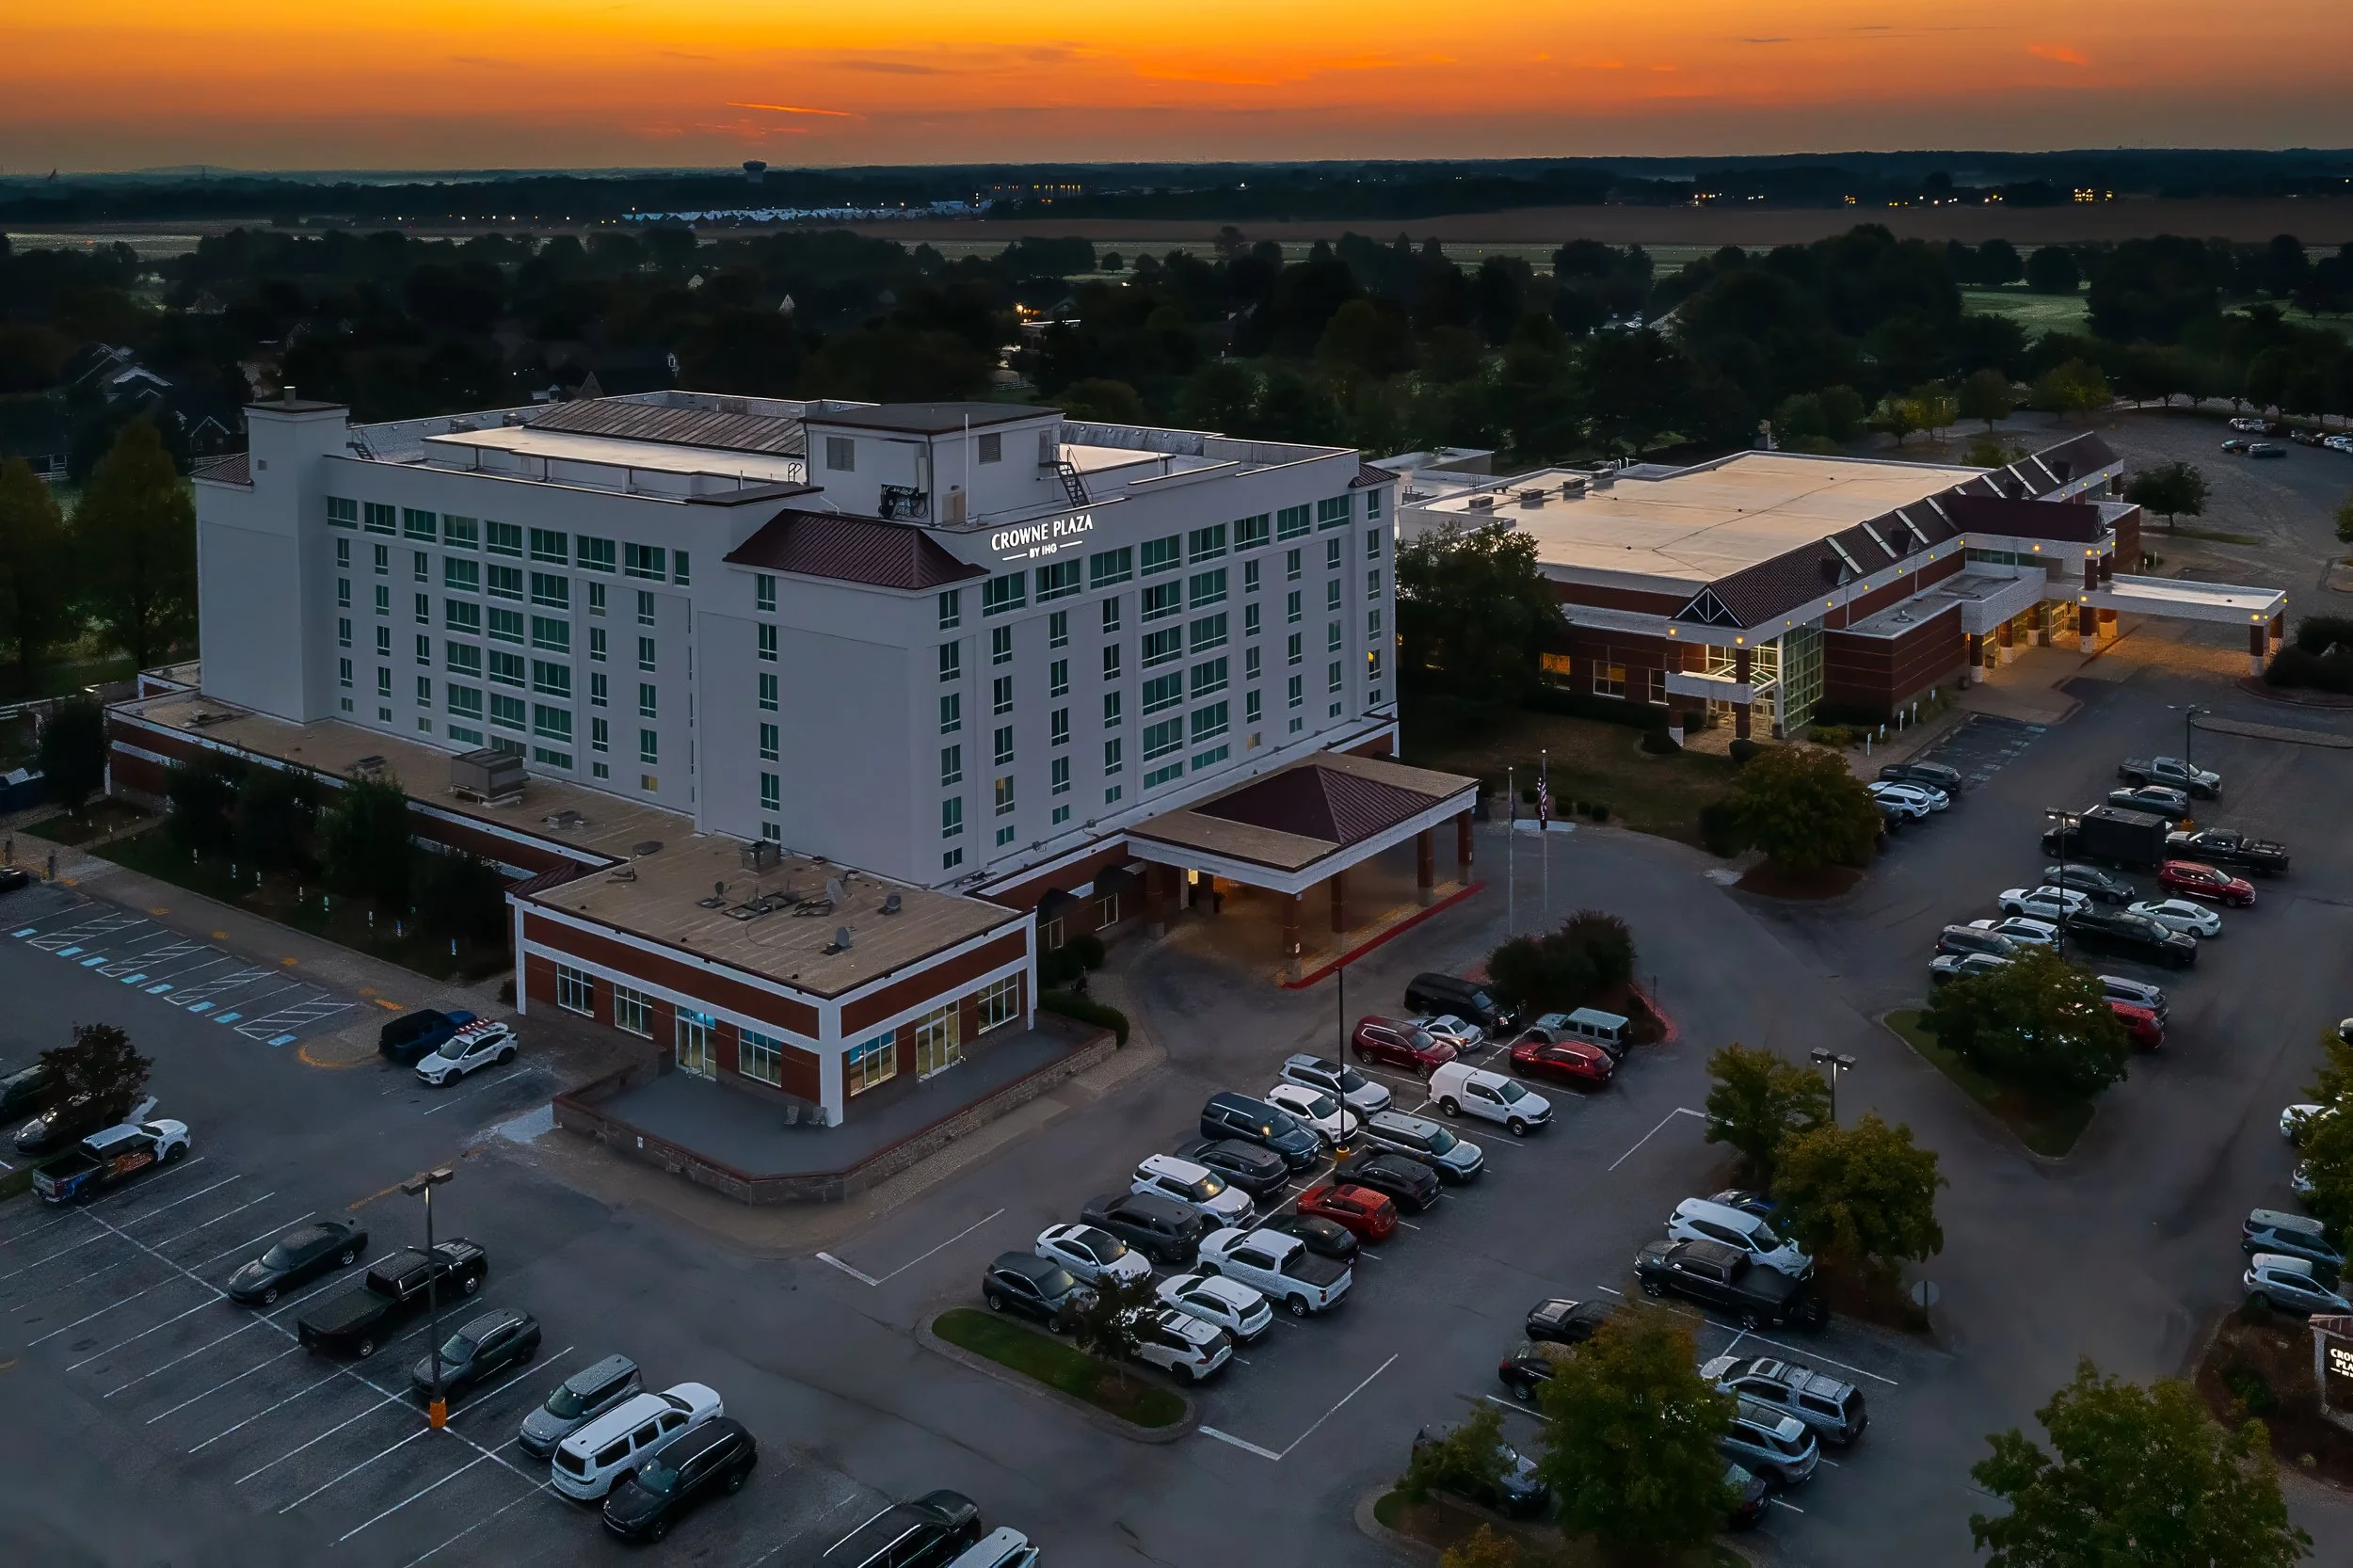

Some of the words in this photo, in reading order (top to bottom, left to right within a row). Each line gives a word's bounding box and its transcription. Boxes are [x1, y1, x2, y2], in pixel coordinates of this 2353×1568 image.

[991, 523, 1048, 551] CROWNE
[1053, 514, 1093, 537] PLAZA
[1029, 546, 1041, 558] BY
[1041, 543, 1057, 555] IHG
